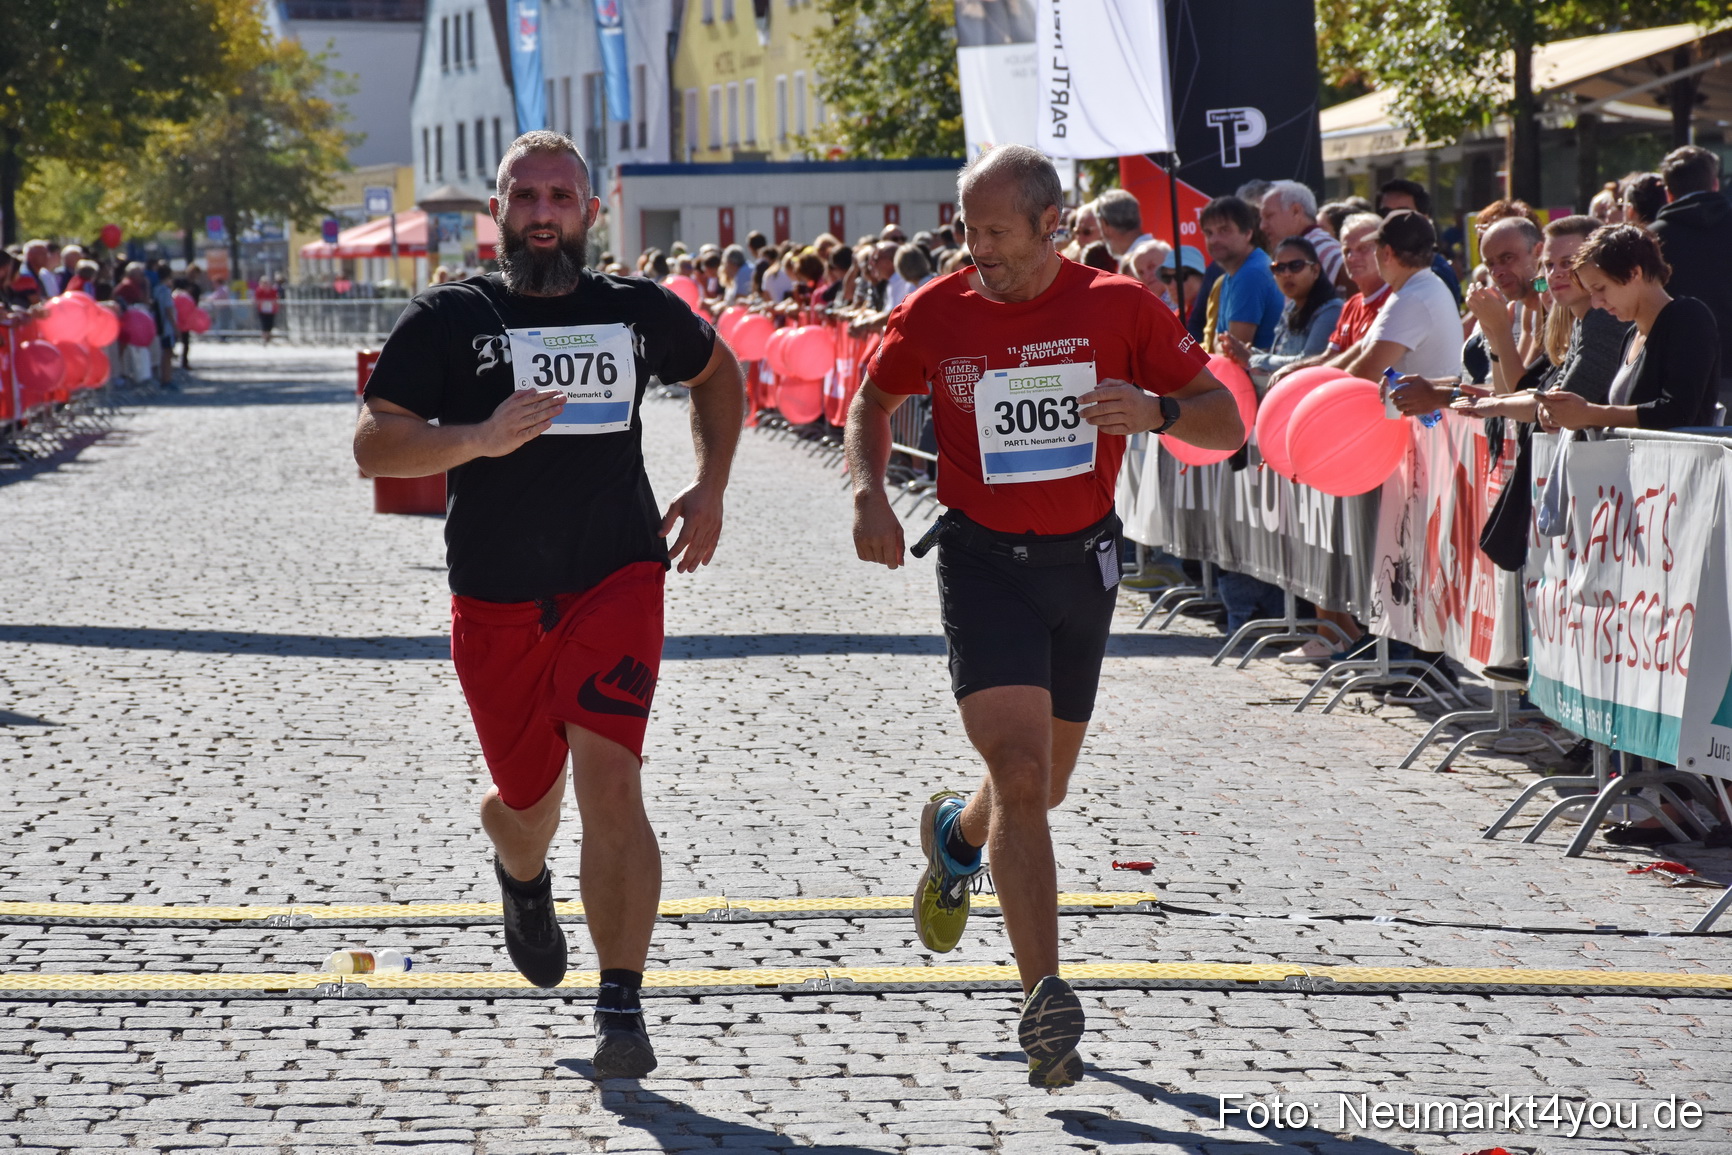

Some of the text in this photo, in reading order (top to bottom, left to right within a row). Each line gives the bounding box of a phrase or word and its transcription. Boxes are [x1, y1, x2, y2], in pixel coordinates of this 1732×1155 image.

[543, 333, 597, 347] BOCK
[1007, 338, 1090, 355] 11. NEUMARKTER
[1020, 346, 1077, 361] STADTLAUF
[531, 351, 618, 387] 3076
[945, 364, 979, 375] IMMER
[945, 373, 980, 384] WIEDER
[1008, 374, 1063, 391] BOCK
[948, 382, 976, 396] NEU
[994, 395, 1081, 435] 3063
[1004, 436, 1066, 447] PARTL Neumarkt
[1593, 588, 1697, 678] BESSER
[1706, 736, 1731, 762] Jura
